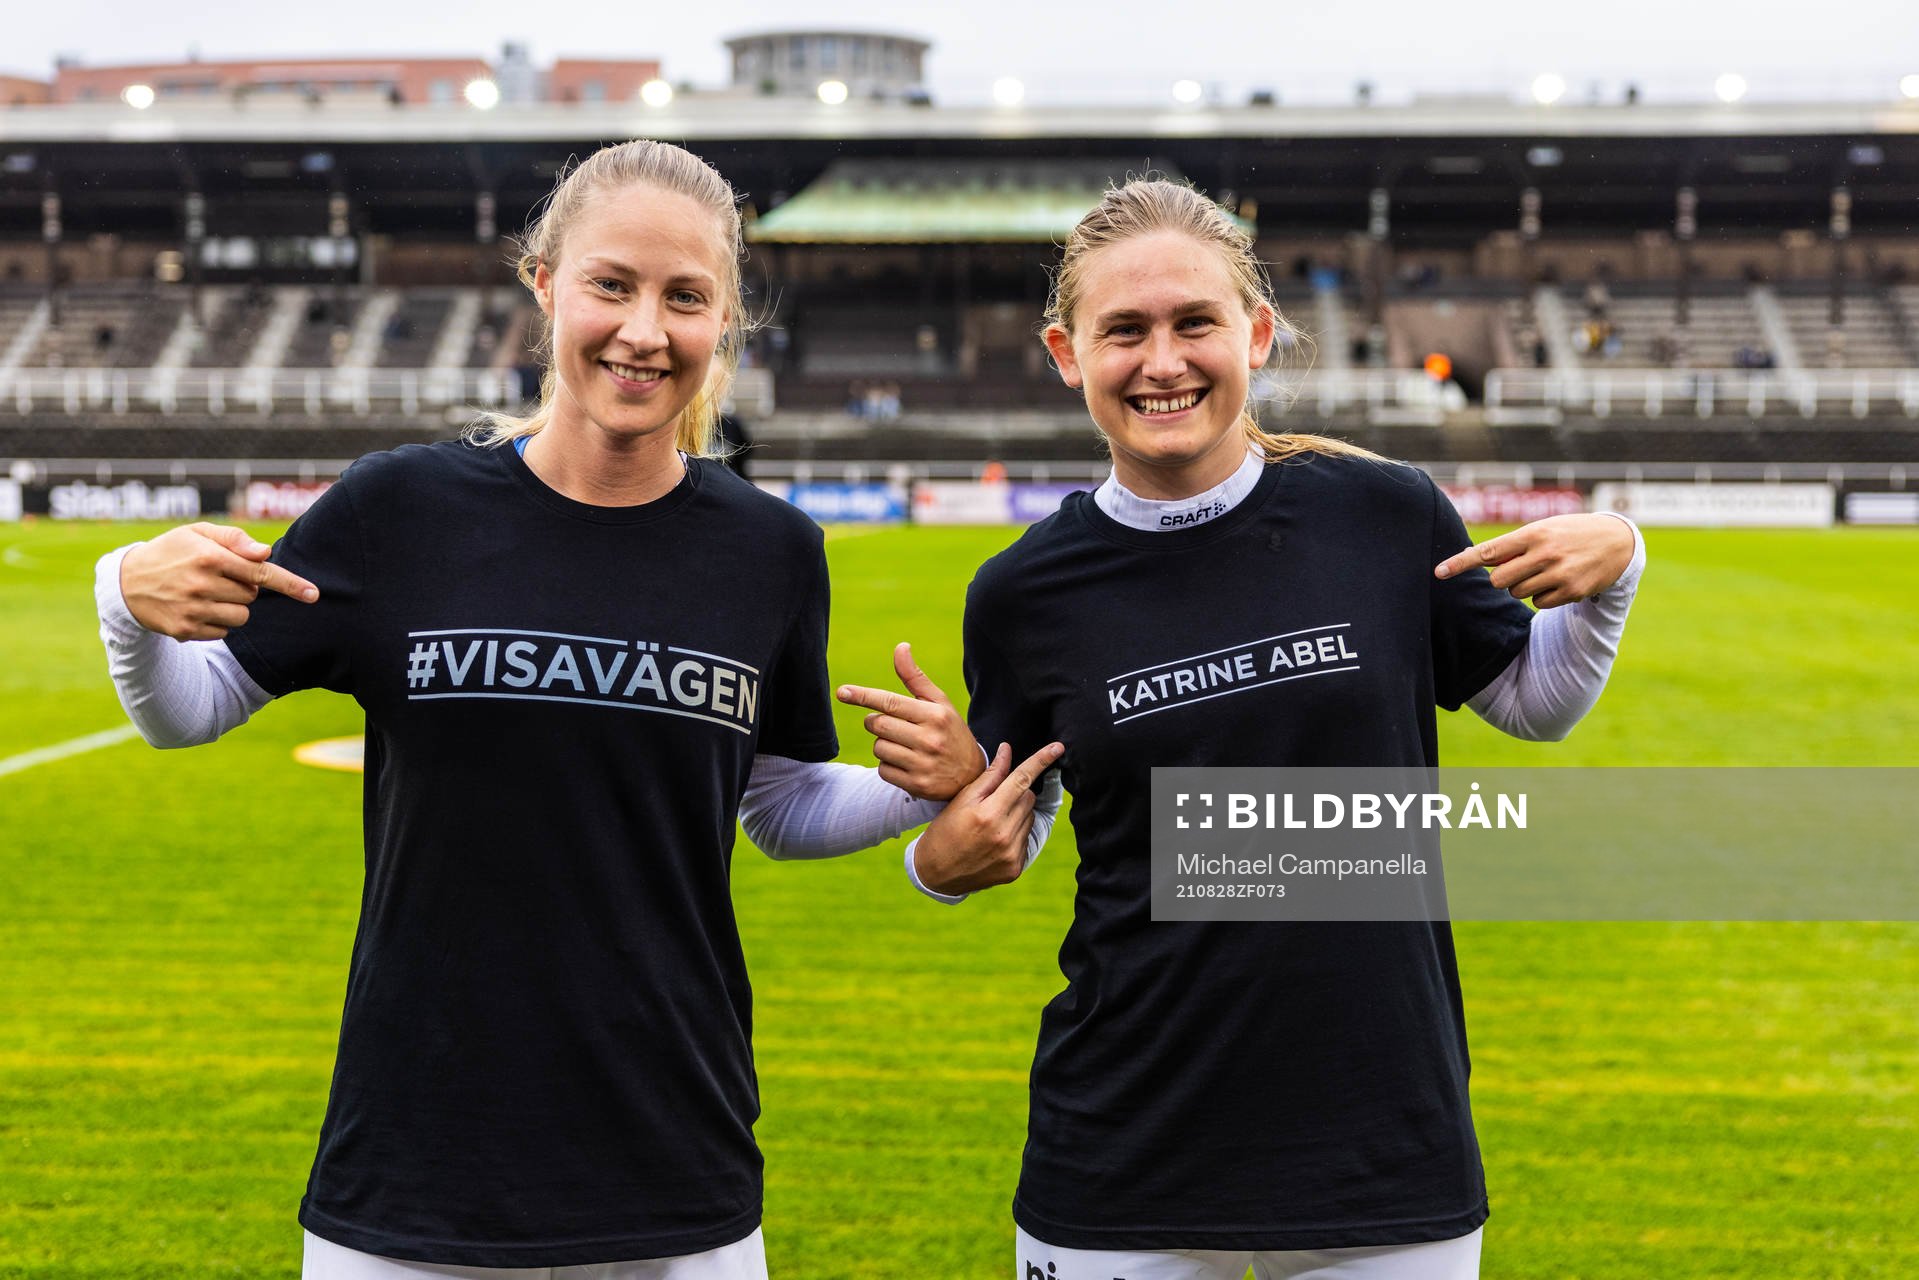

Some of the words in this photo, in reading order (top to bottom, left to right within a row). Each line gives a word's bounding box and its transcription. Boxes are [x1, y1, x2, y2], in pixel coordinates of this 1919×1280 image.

[50, 480, 200, 519] stadium
[1160, 507, 1211, 526] CRAFT
[407, 640, 758, 724] #VISAVÄGEN
[1108, 653, 1257, 714] KATRINE
[1269, 635, 1358, 673] ABEL
